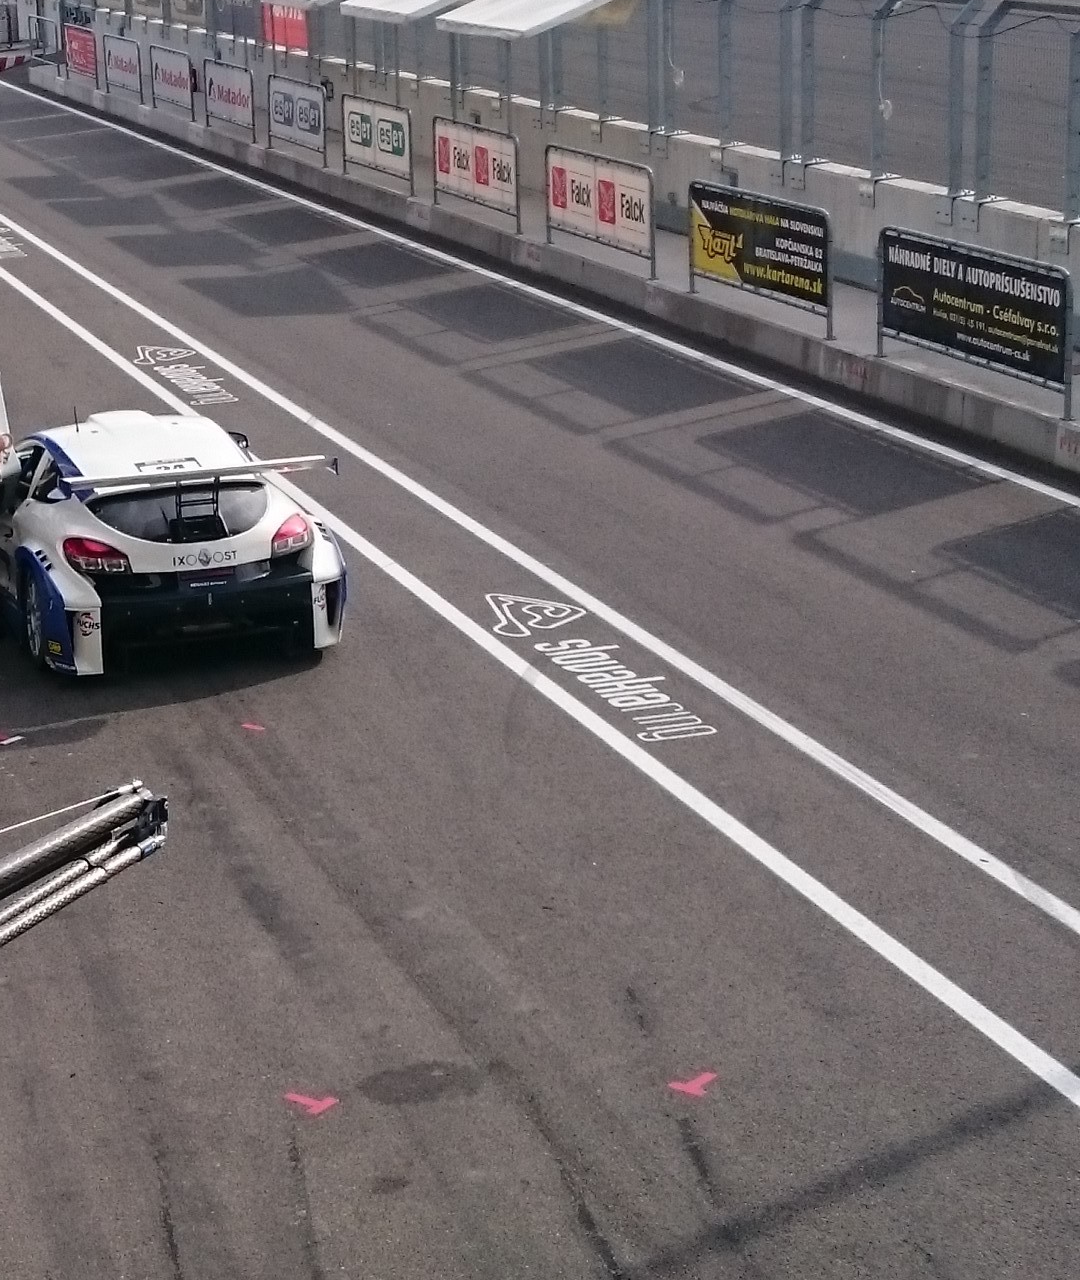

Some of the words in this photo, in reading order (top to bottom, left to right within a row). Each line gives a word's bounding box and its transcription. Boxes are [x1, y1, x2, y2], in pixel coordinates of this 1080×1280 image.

[161, 66, 189, 91] Matador
[217, 84, 250, 109] Matador
[453, 146, 470, 172] Falck
[492, 157, 513, 185] Falck
[571, 179, 592, 208] Falck
[620, 193, 646, 224] Falck
[780, 217, 790, 228] NA
[754, 246, 824, 274] BRATISLAVA-PETRŽALKA
[888, 244, 931, 271] NÁHRADNÉ
[933, 256, 957, 278] DIELY
[957, 263, 964, 280] A
[965, 266, 1061, 308] AUTOPRÍSLUŠENSTVO
[743, 262, 824, 295] www.kartarena.sk
[933, 287, 984, 315] Autocentrum
[992, 304, 1036, 334] Cséfalvay
[1036, 321, 1060, 337] s.r.o.
[77, 619, 100, 630] FUCHS
[533, 638, 718, 743] slovakiaring
